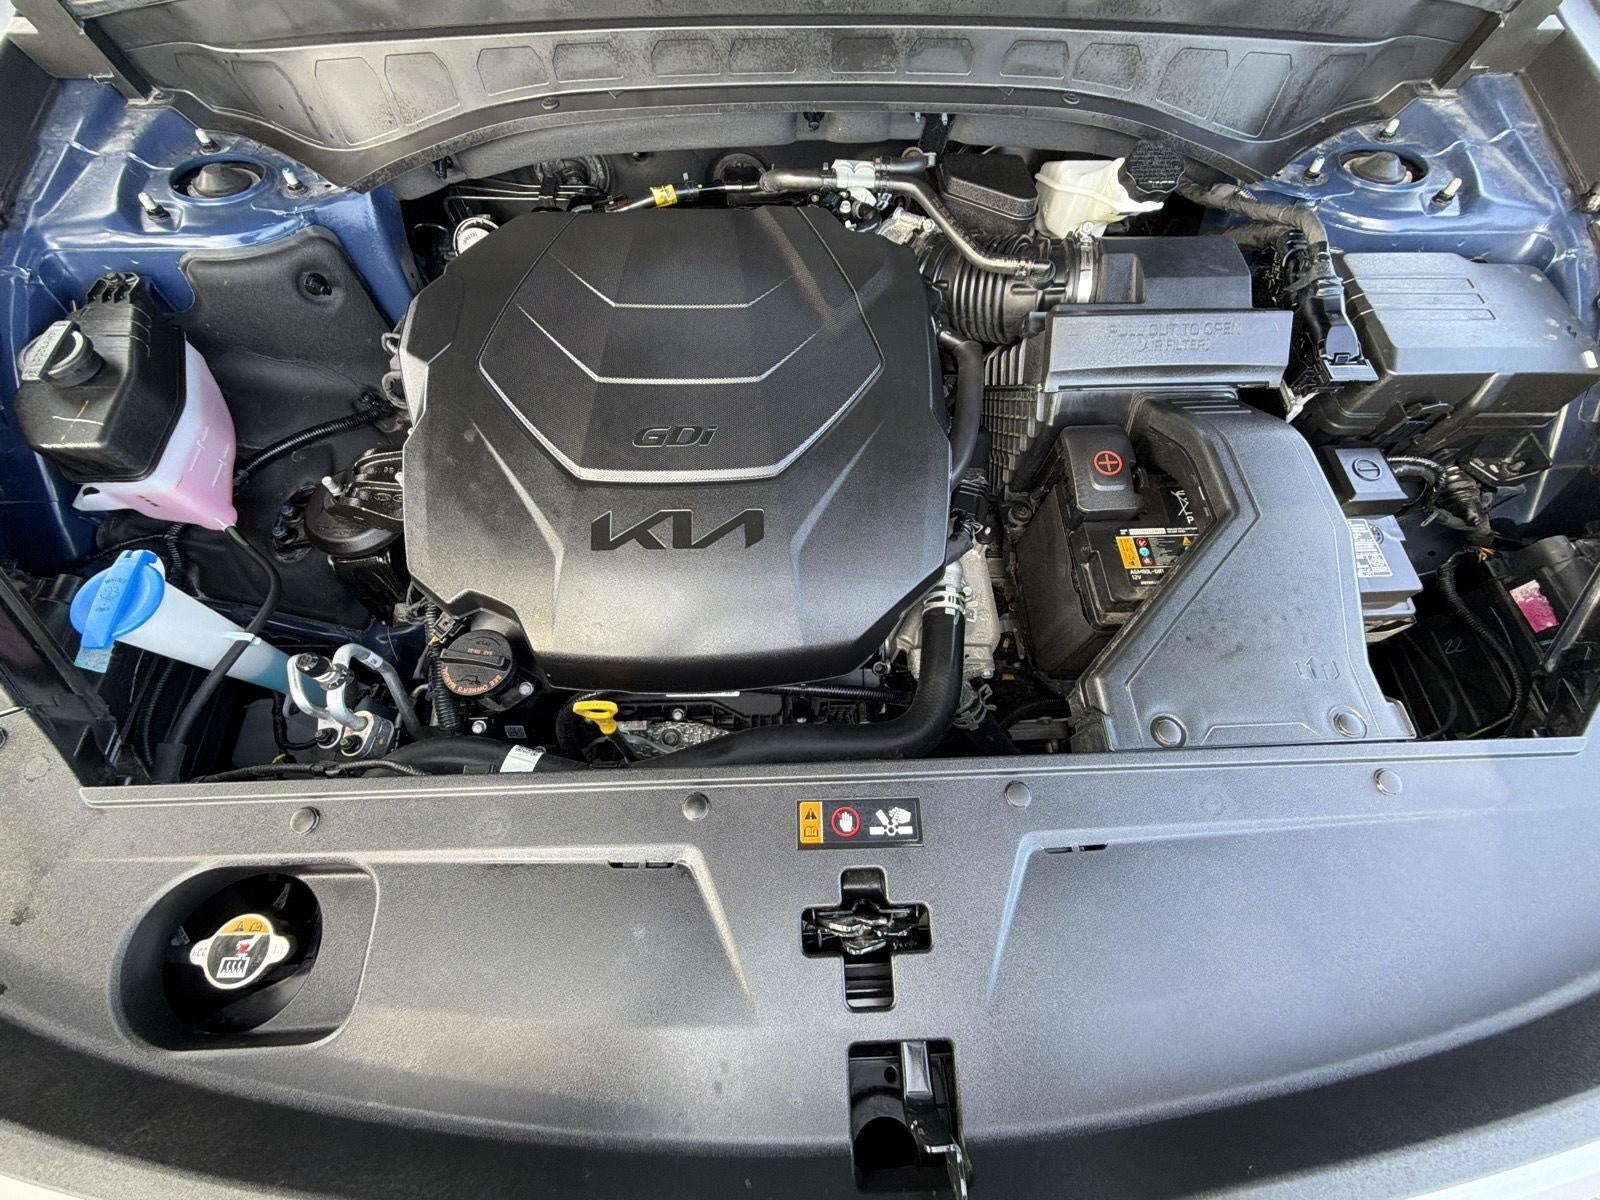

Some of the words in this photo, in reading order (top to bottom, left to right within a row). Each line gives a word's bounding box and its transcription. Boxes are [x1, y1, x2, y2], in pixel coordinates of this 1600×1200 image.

[1149, 323, 1178, 337] OUT
[1182, 323, 1200, 336] TO
[1204, 321, 1242, 336] OPEN
[632, 425, 718, 448] GDi
[590, 508, 765, 551] KIA
[441, 666, 458, 689] MANUAL
[488, 674, 502, 687] SEE
[457, 684, 488, 694] OWNER'S
